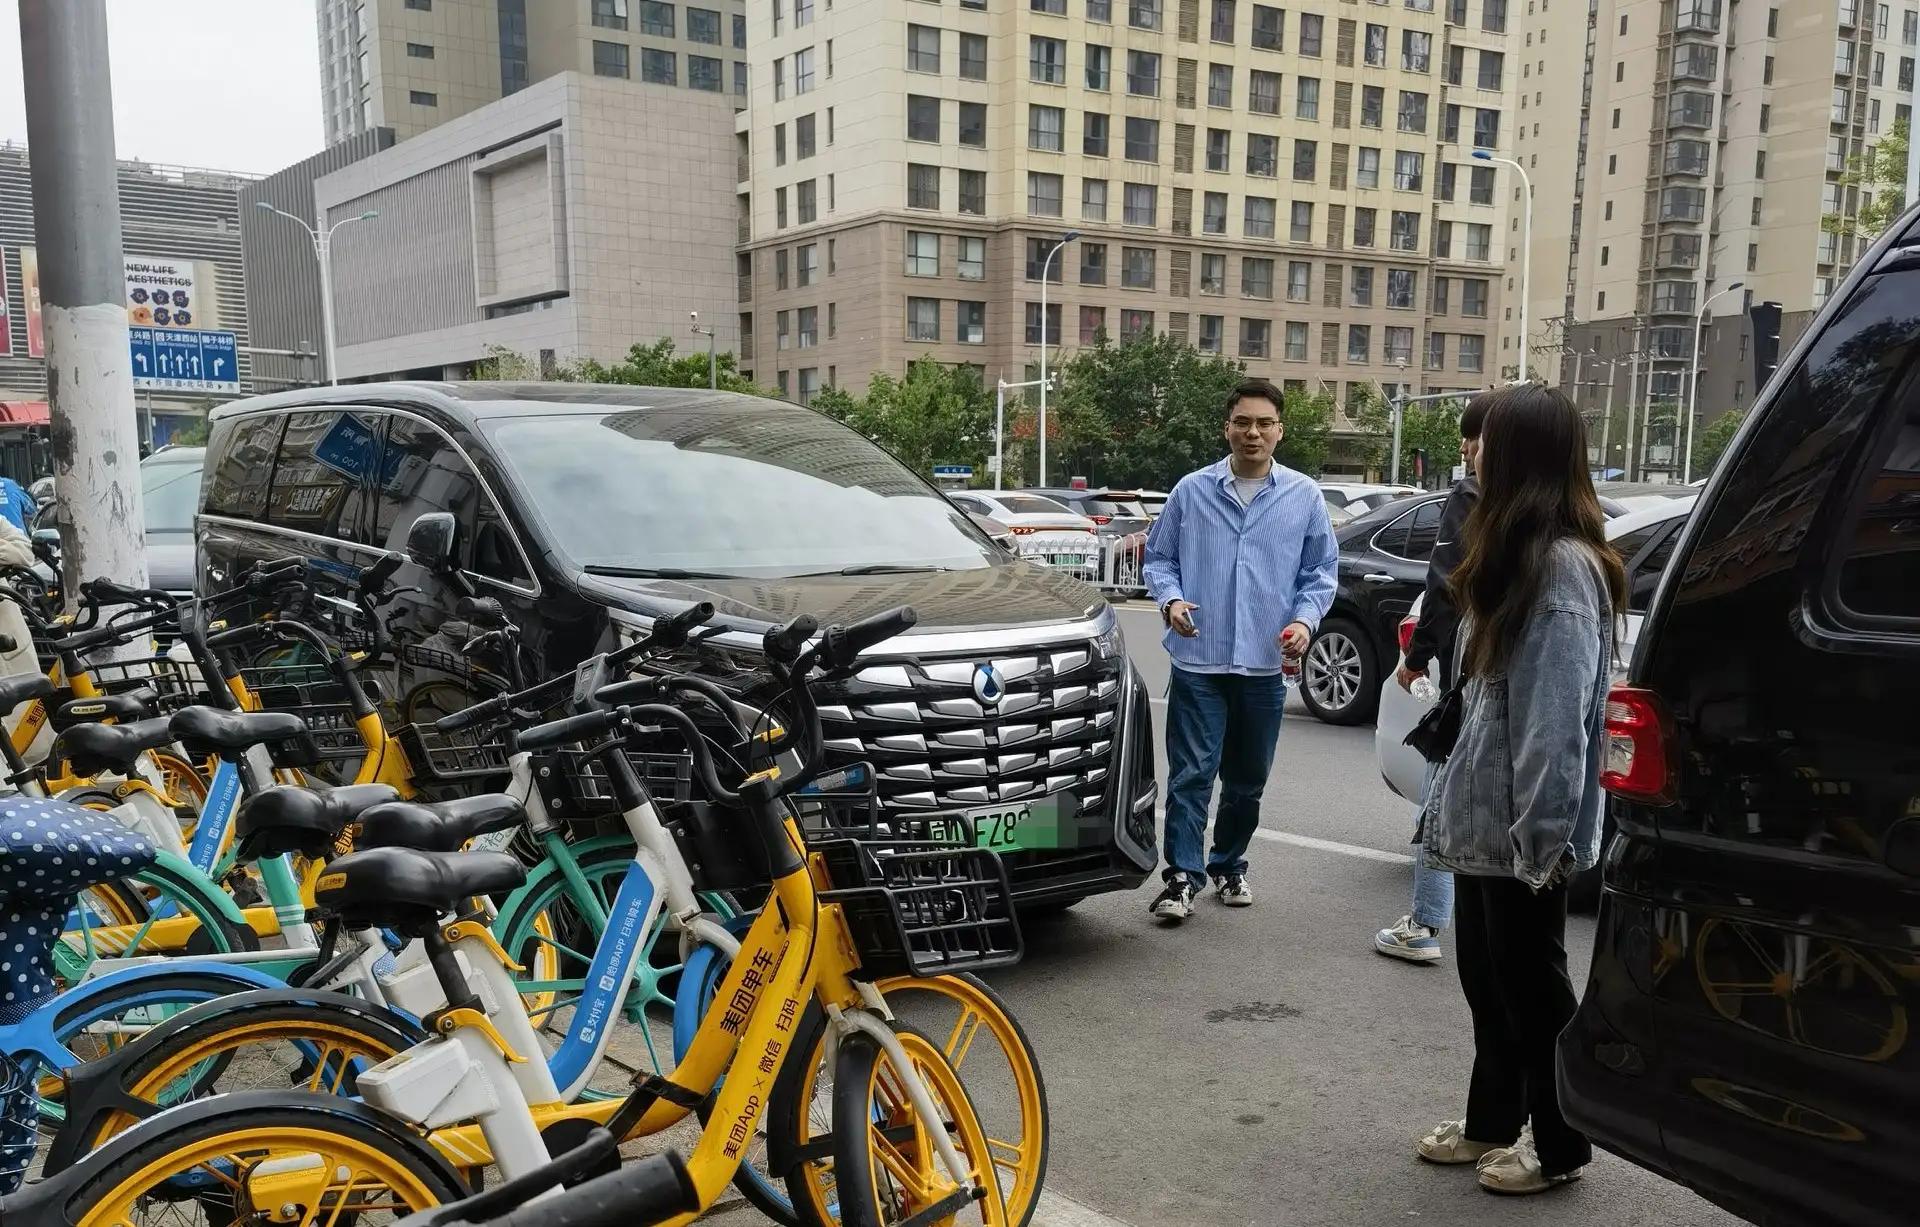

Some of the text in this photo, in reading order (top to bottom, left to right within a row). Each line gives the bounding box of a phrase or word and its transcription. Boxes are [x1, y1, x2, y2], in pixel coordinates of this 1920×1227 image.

[126, 263, 176, 275] NEW LIFE
[127, 274, 192, 287] AESTHETICS
[720, 947, 773, 1036] 美团单车
[723, 1095, 759, 1160] 美团App
[758, 1038, 782, 1074] 微信
[775, 998, 799, 1032] 扫码
